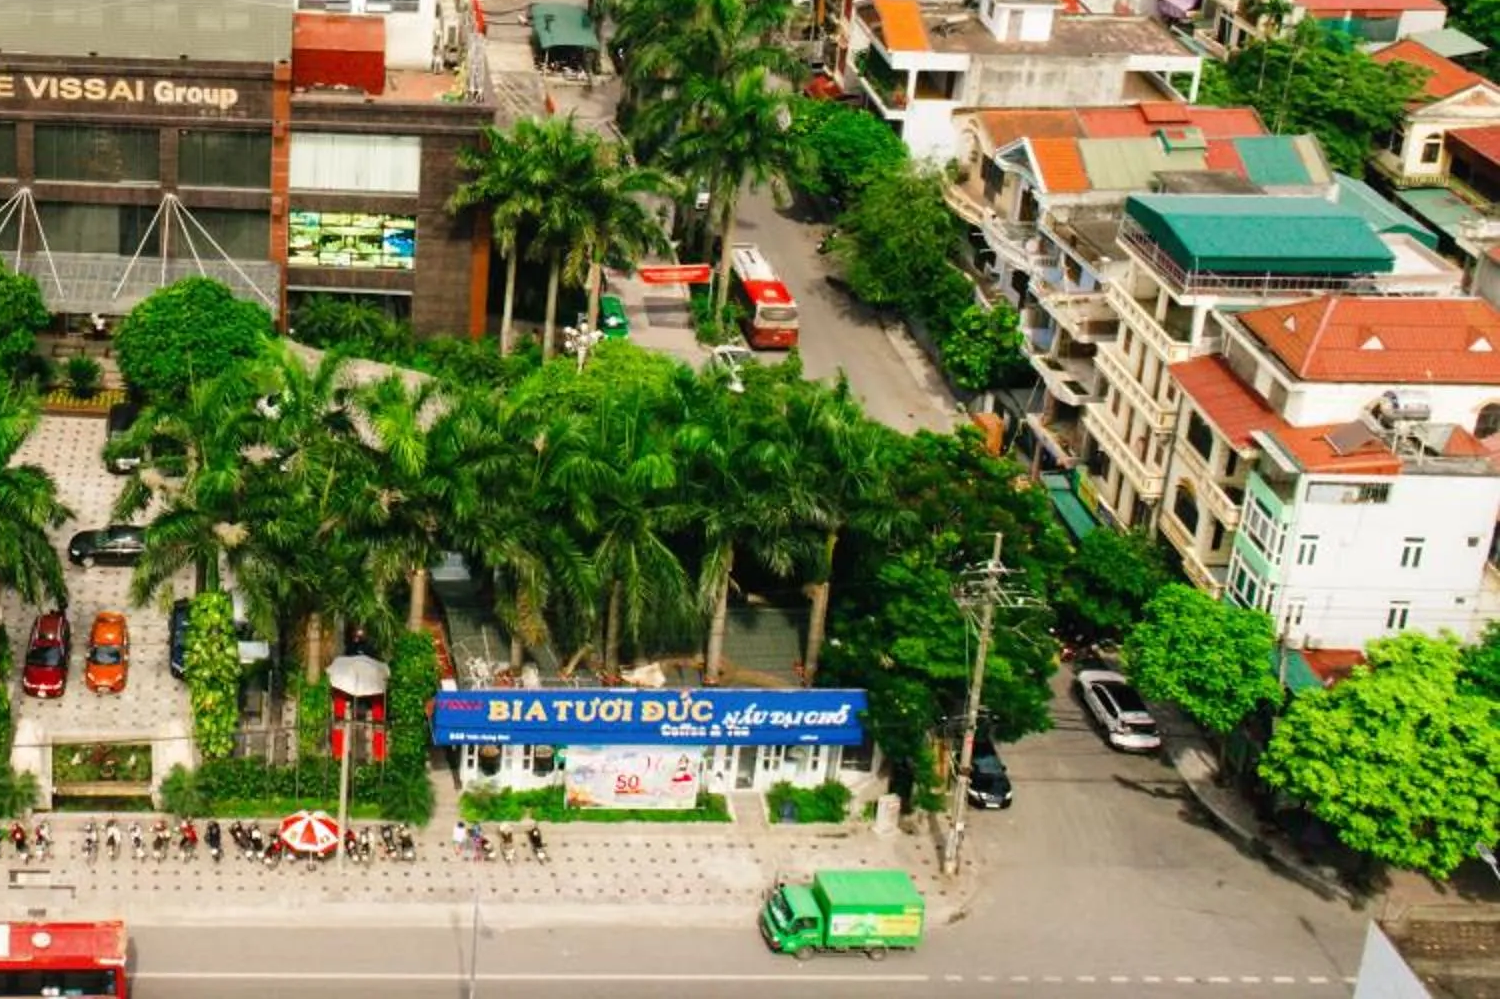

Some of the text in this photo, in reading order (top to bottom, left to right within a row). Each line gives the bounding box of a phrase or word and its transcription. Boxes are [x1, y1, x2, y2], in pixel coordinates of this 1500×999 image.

[24, 76, 144, 101] VISSAI
[153, 80, 238, 109] Group
[487, 699, 548, 722] BIA
[553, 696, 633, 722] TƯƠI
[640, 689, 714, 722] ĐỨC
